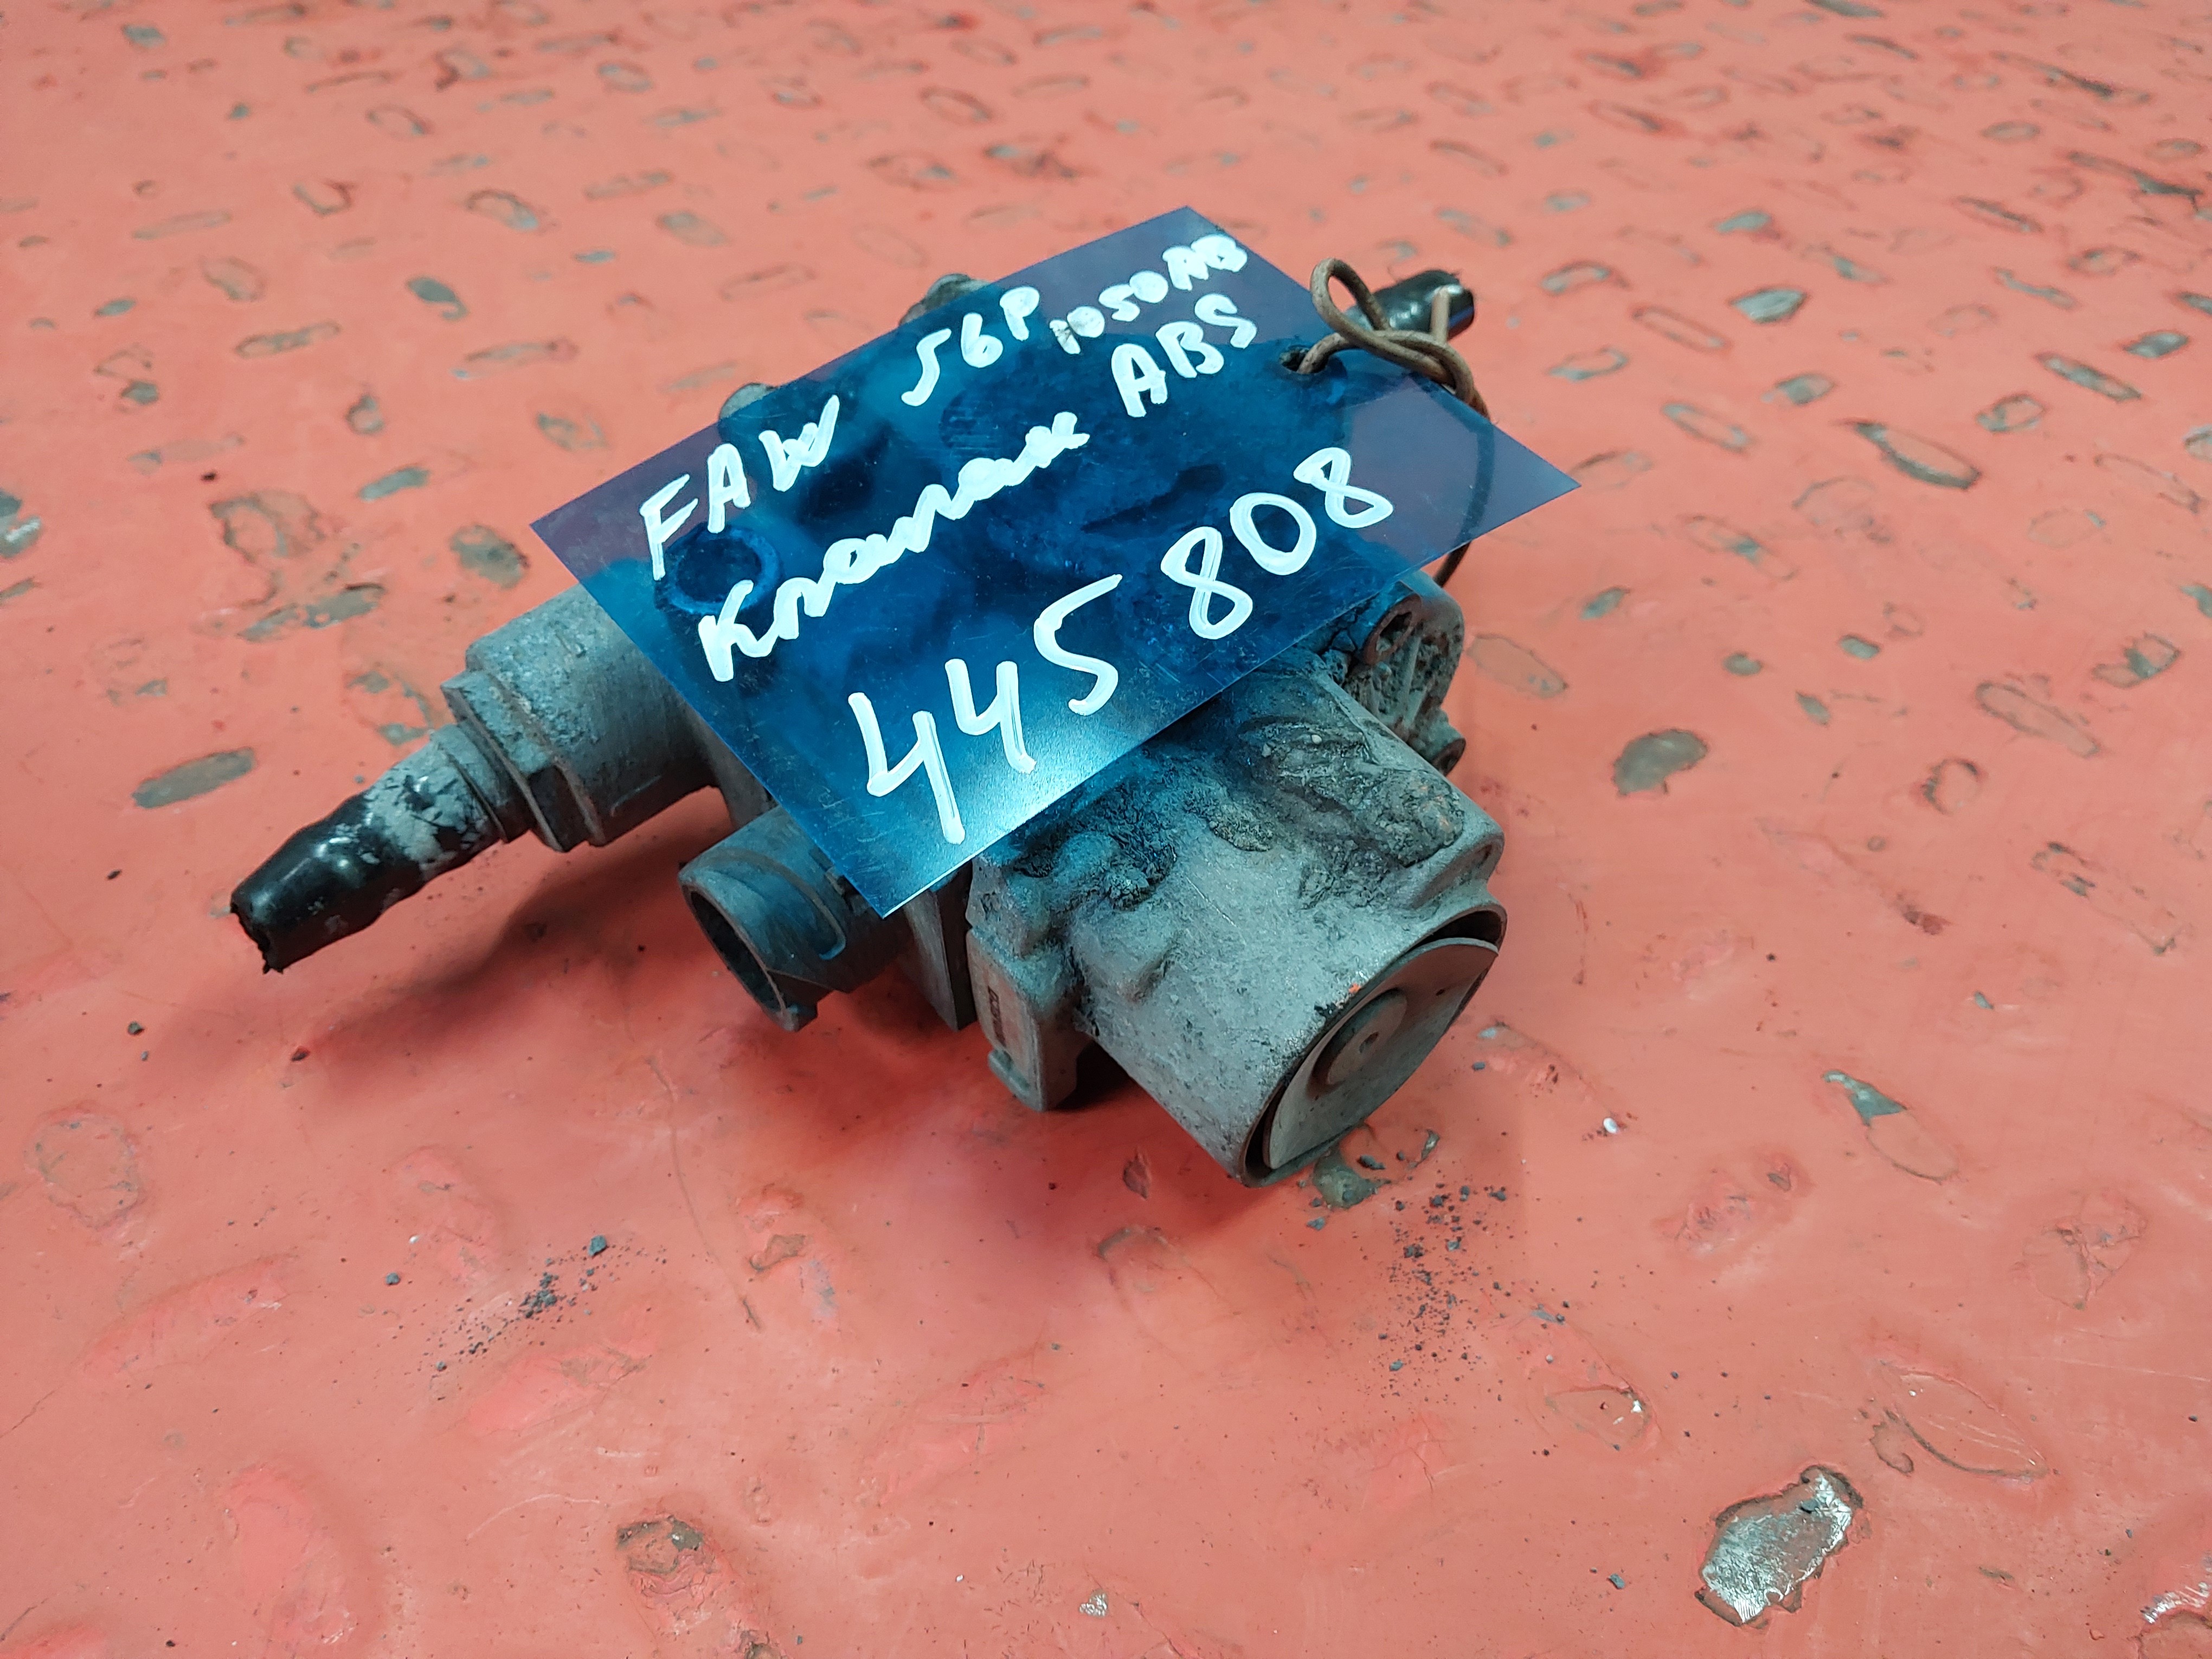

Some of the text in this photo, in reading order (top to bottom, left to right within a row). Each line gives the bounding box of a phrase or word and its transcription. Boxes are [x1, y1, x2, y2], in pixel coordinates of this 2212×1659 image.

[639, 394, 840, 581] FAW
[847, 446, 1394, 846] 445 808
